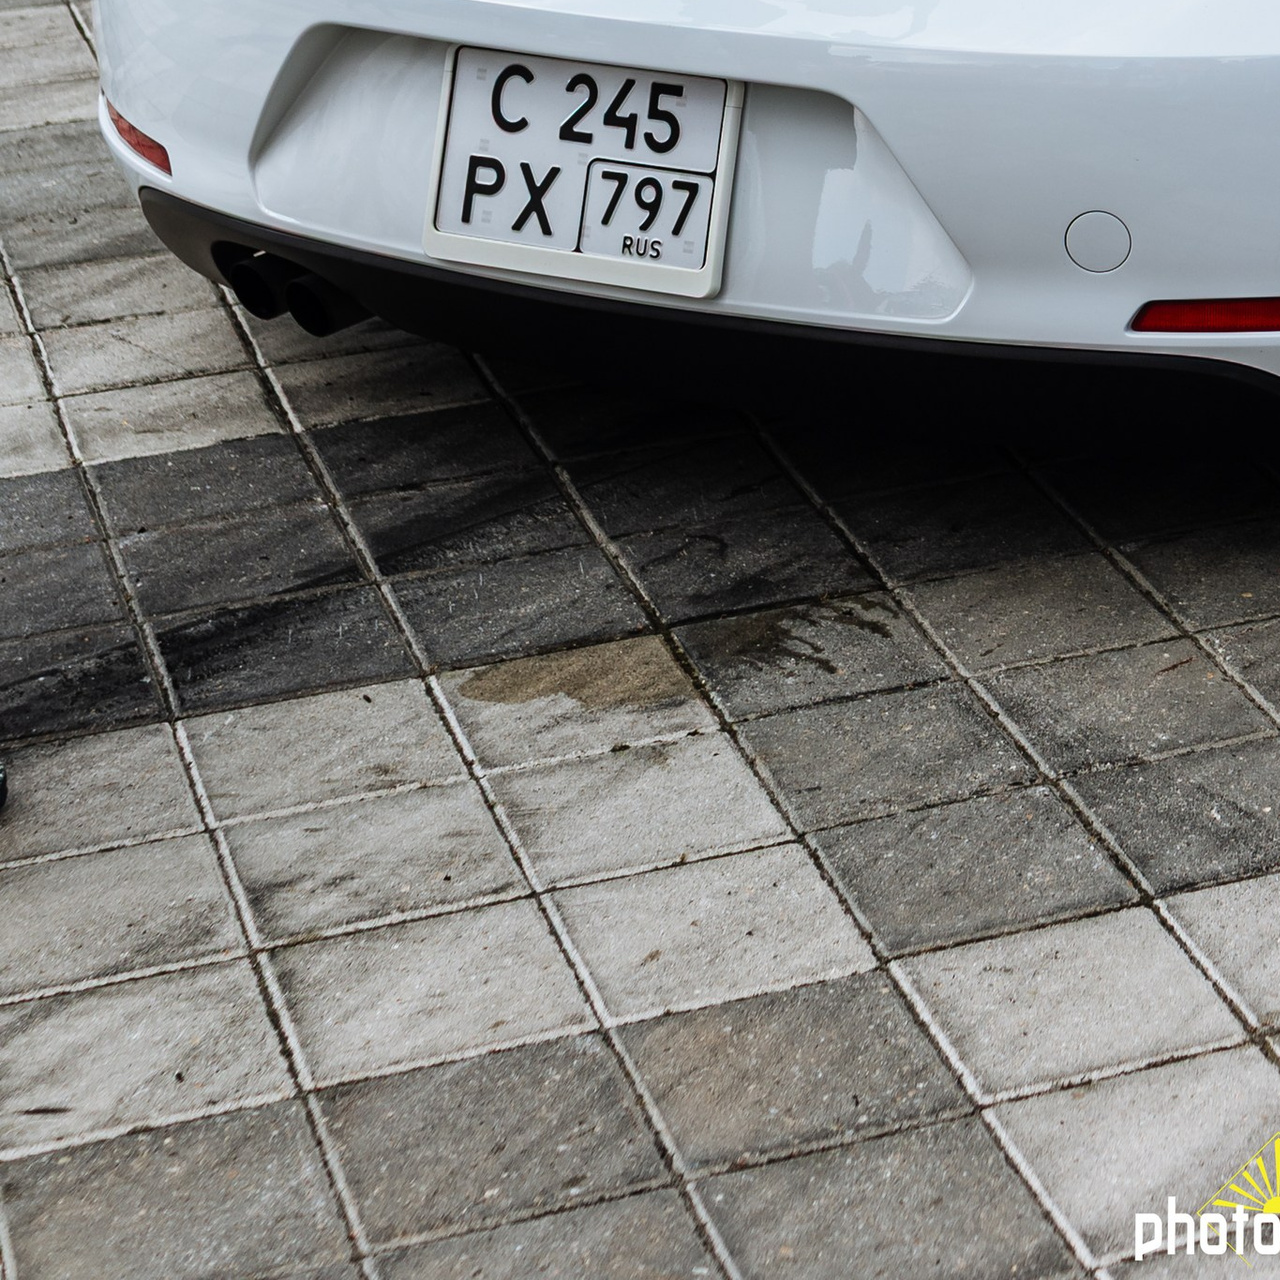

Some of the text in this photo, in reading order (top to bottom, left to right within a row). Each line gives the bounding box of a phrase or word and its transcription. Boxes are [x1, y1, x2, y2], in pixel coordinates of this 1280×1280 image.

[558, 73, 685, 154] 245
[600, 170, 700, 236] 797
[621, 235, 663, 259] RUS
